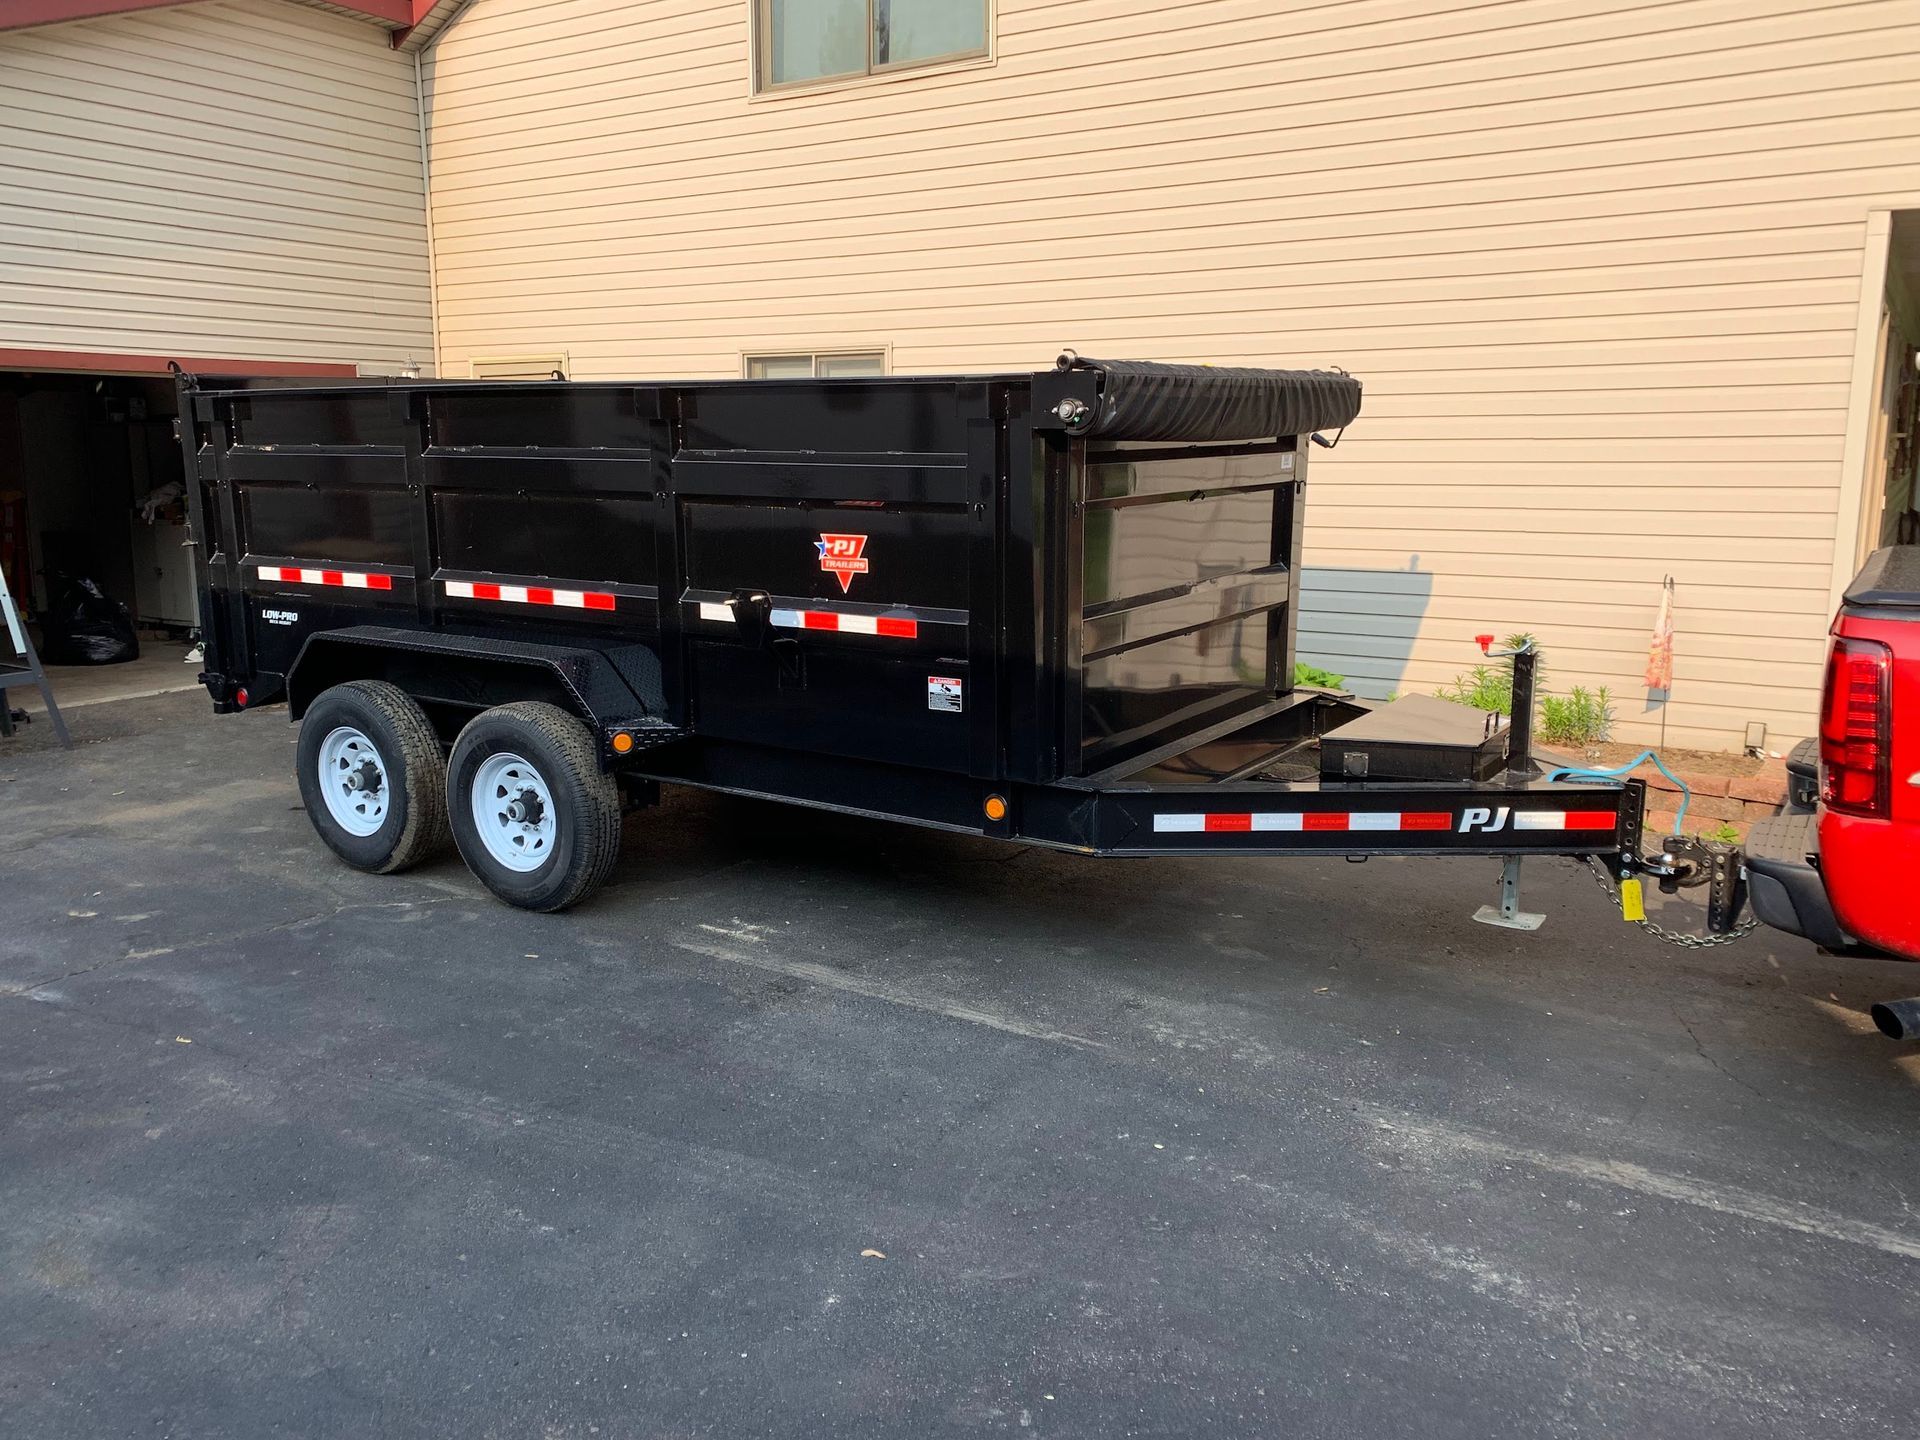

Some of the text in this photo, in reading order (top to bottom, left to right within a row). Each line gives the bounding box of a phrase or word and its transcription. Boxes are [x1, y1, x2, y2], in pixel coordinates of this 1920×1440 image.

[833, 539, 857, 556] PJ
[825, 560, 866, 569] TRAILERS
[262, 609, 298, 622] LOW-PRO
[1458, 807, 1510, 833] PJ
